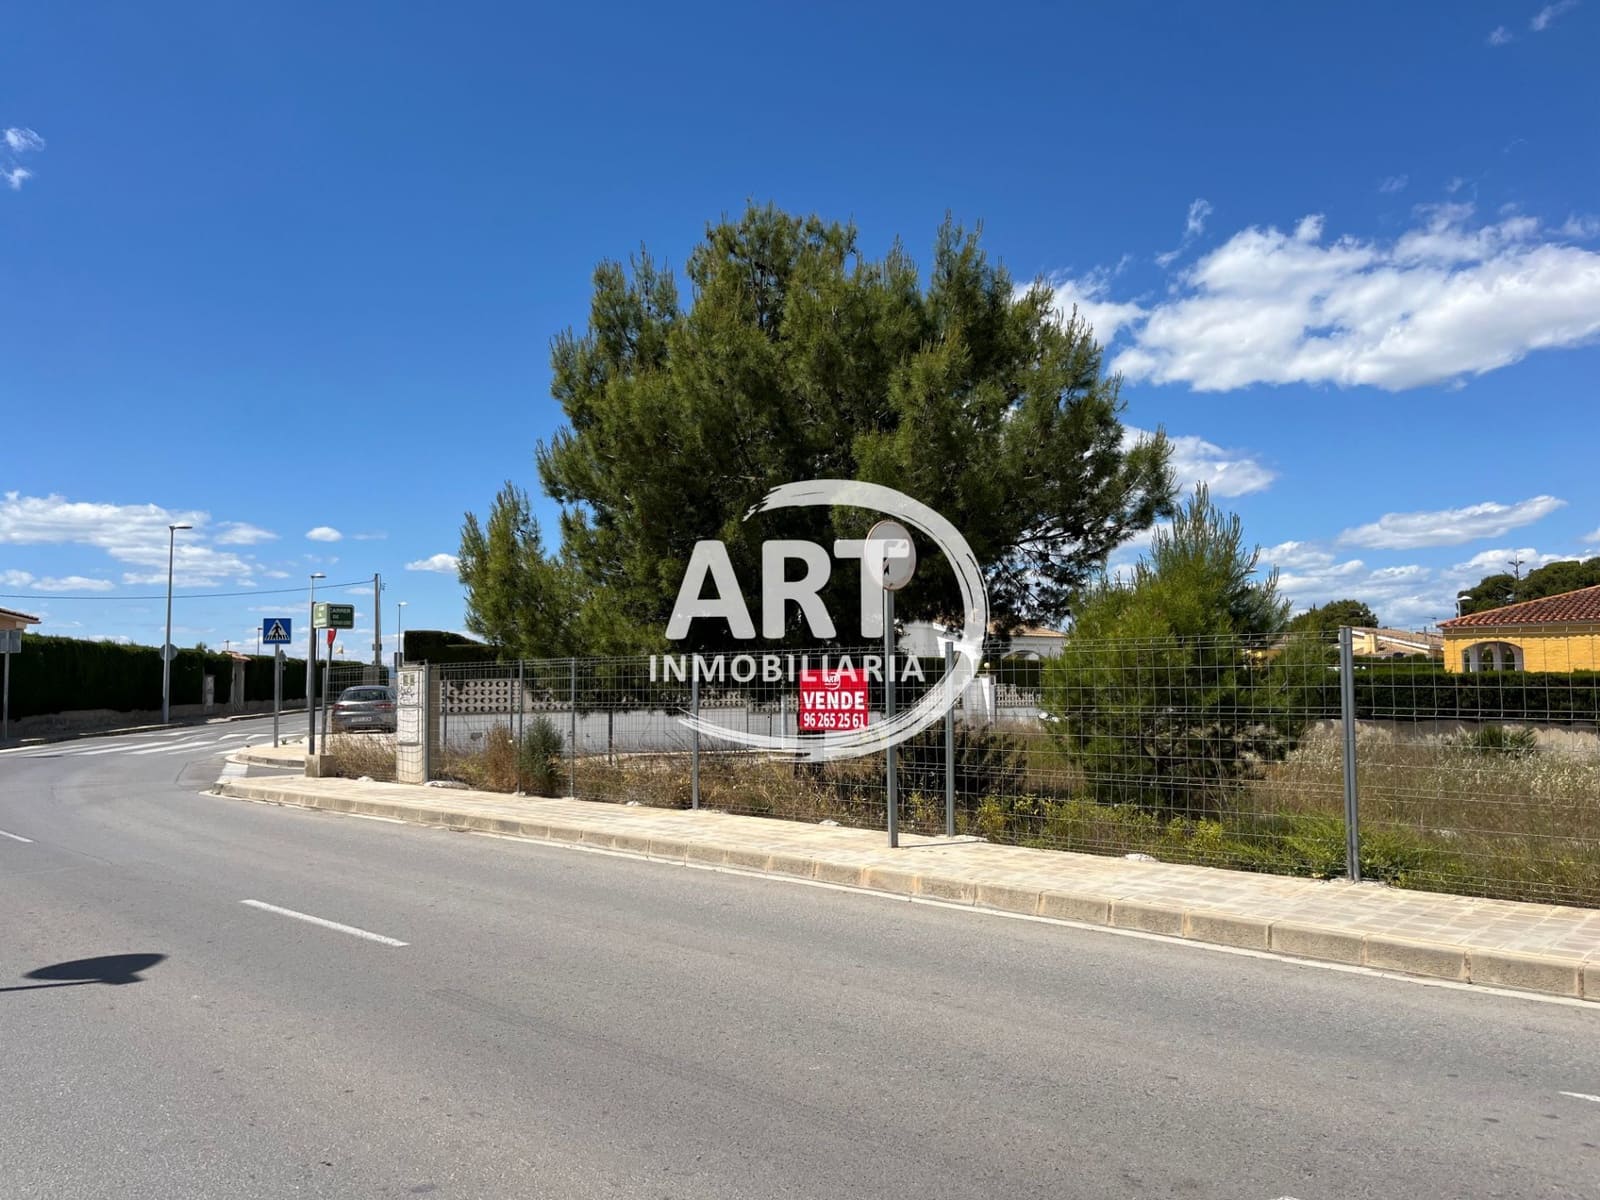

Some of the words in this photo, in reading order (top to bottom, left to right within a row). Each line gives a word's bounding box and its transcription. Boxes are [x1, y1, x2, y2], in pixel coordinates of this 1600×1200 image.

[803, 691, 865, 710] VENDE
[803, 712, 816, 728] 96
[817, 712, 836, 728] 265
[838, 713, 851, 728] 25
[852, 713, 864, 728] 61
